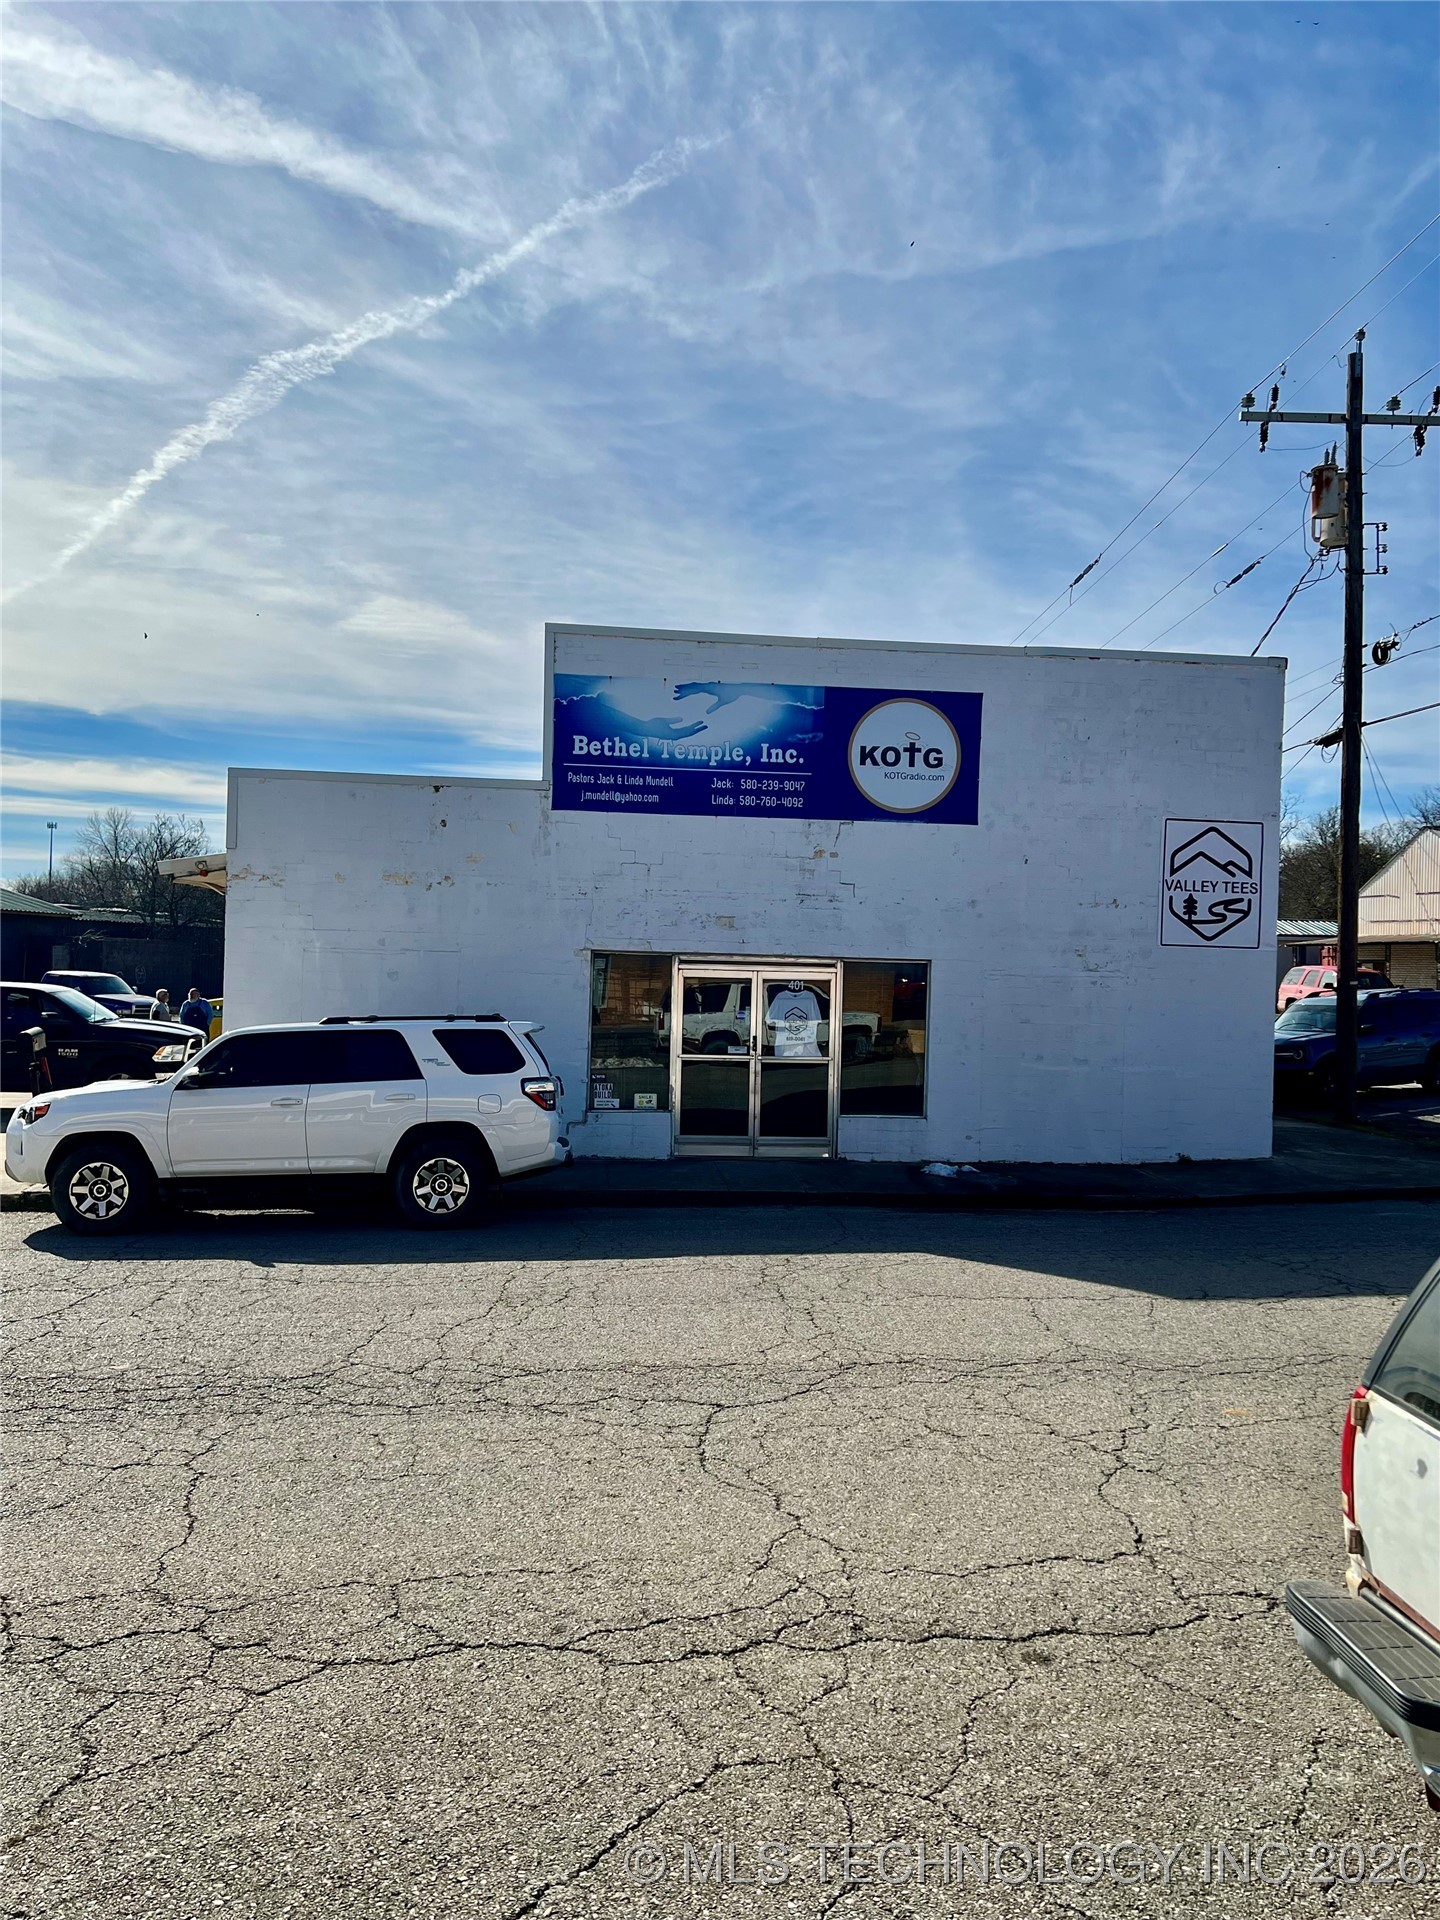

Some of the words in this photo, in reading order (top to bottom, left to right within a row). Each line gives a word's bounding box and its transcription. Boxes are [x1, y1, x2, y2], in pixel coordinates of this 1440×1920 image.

[572, 735, 649, 758] Bethel
[658, 738, 751, 766] Temple,
[760, 743, 804, 764] Inc.
[567, 772, 594, 784] Pastors
[597, 773, 614, 784] Jack
[617, 774, 622, 785] &
[624, 774, 643, 786] Linda
[645, 775, 674, 787] Mundell
[884, 771, 945, 781] KOTGradio.com
[711, 778, 734, 789] Jack:
[740, 779, 805, 791] 580-239-9047
[581, 790, 659, 804] j.mundell@yahoo.com
[711, 794, 736, 806] Linda:
[739, 795, 803, 808] 580-760-4092
[1165, 879, 1219, 893] VALLEY
[1221, 881, 1258, 894] TEES
[788, 981, 804, 990] 401
